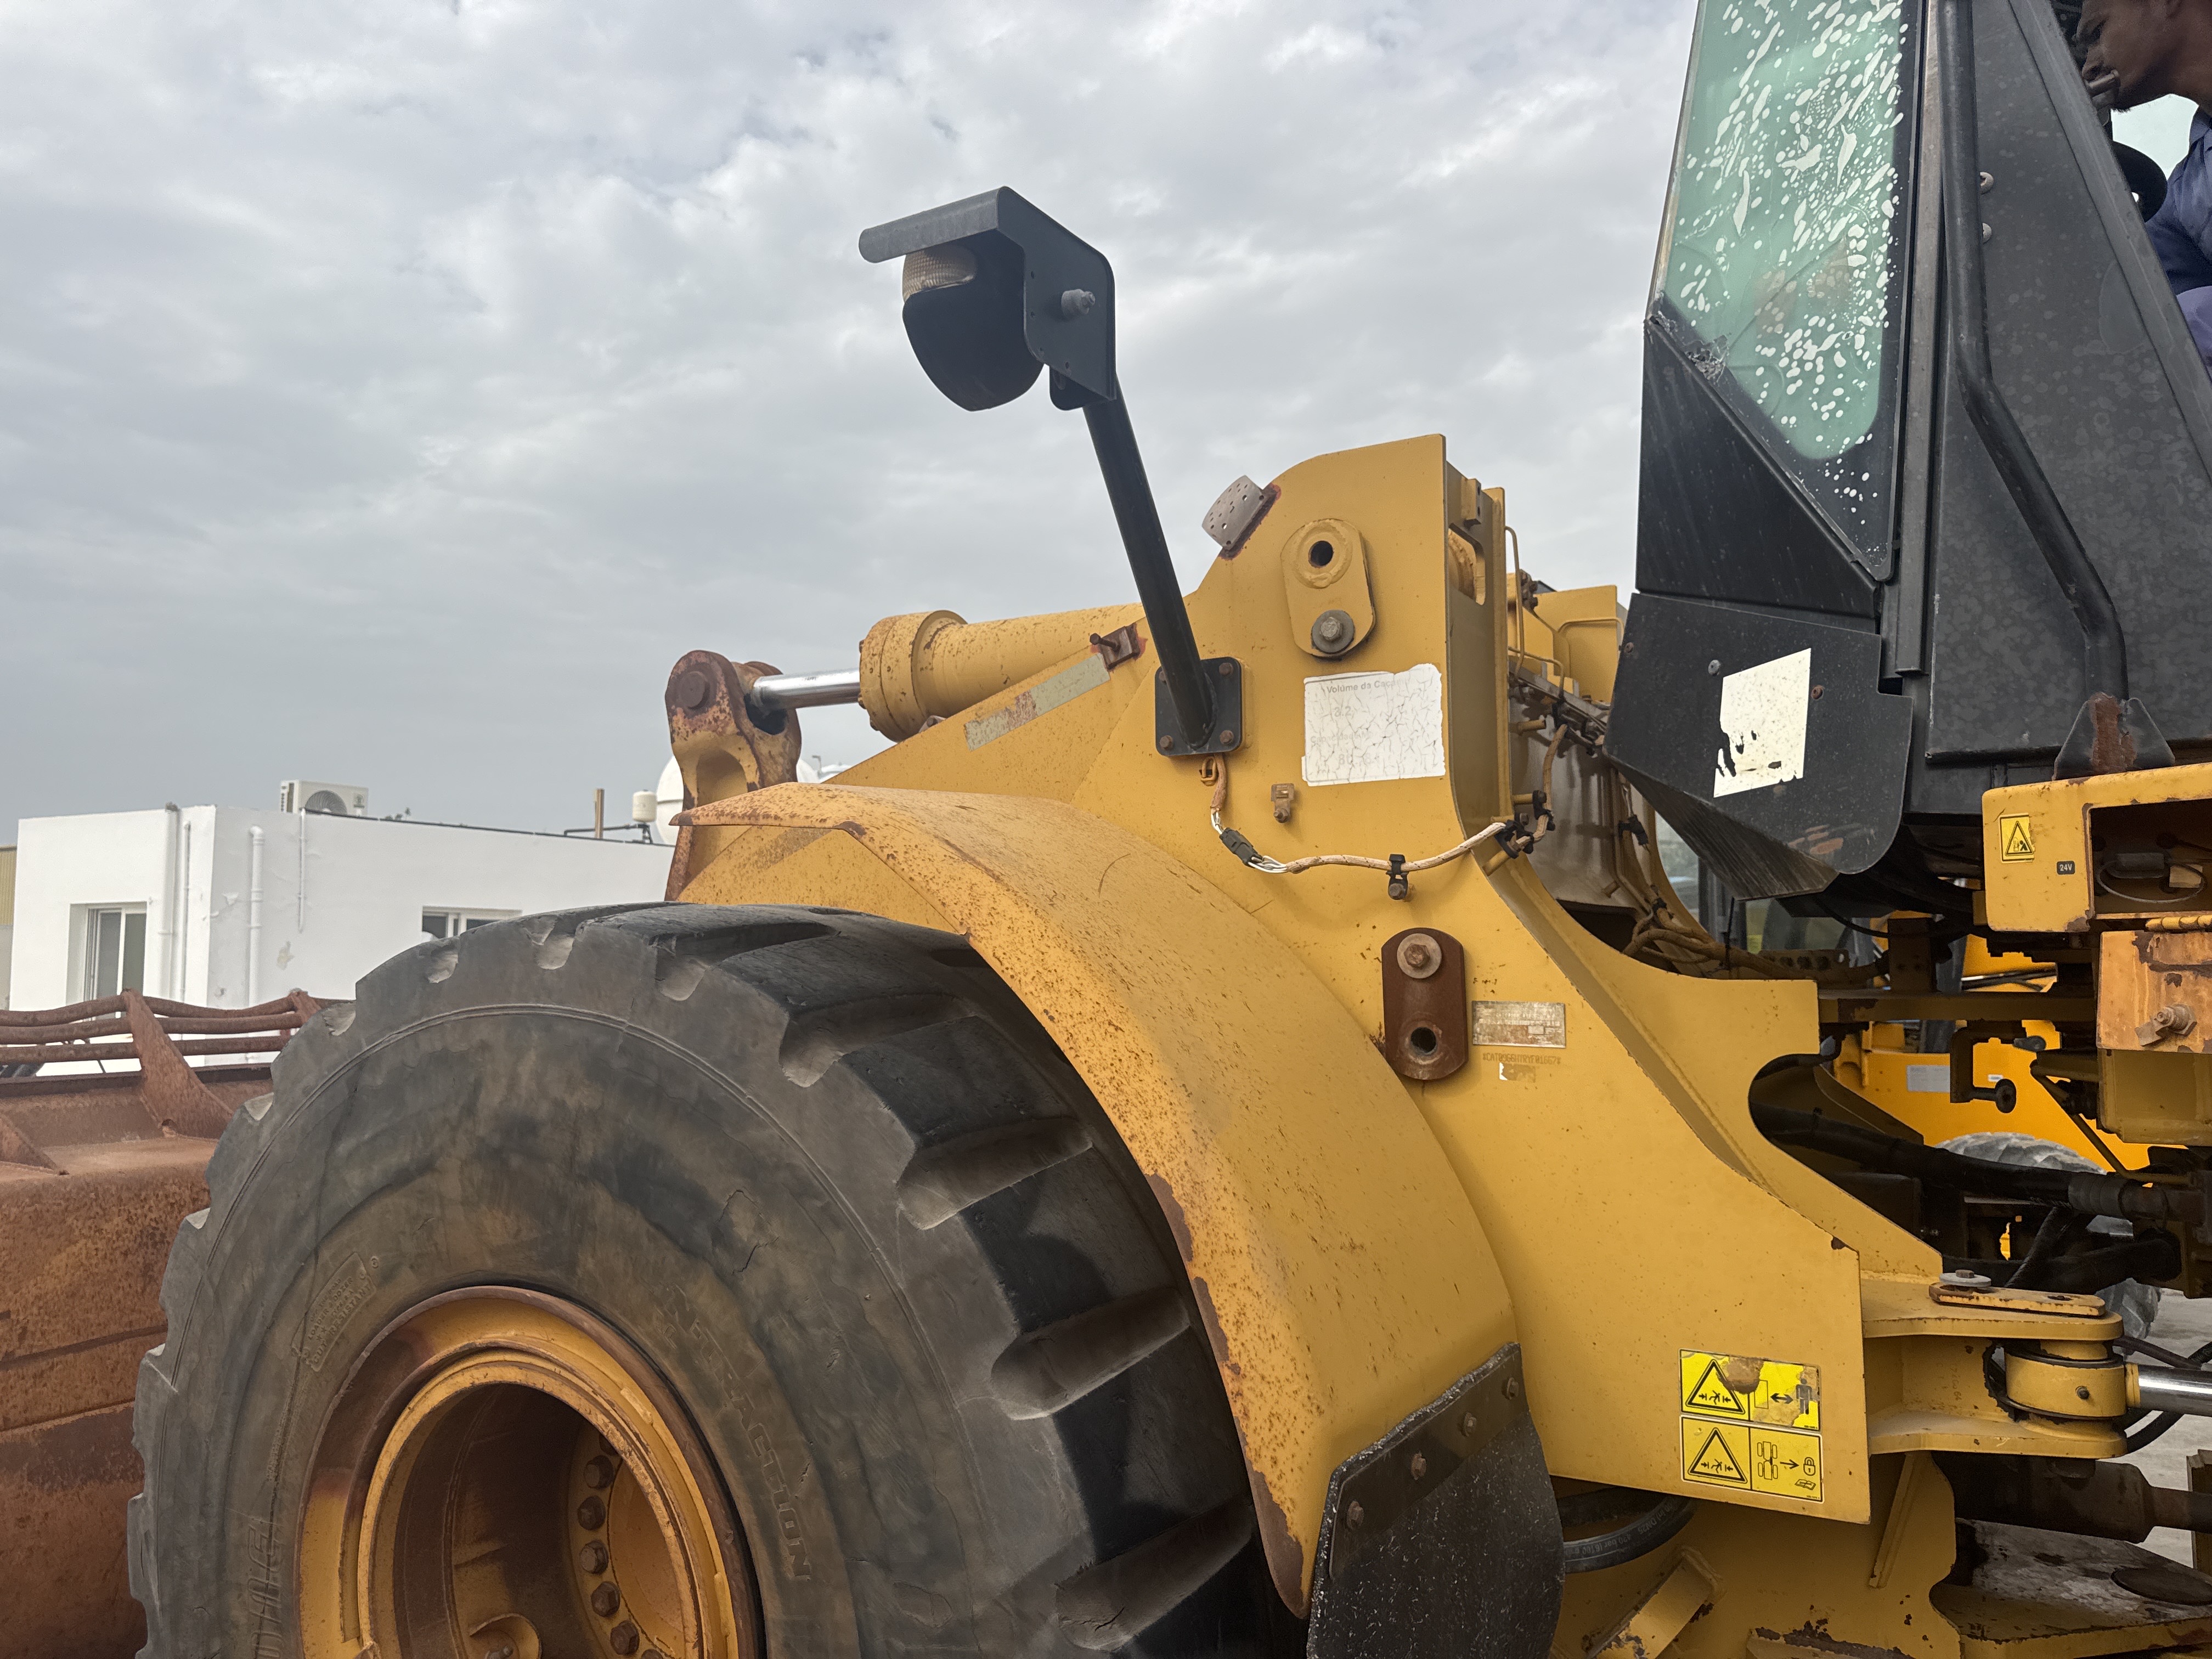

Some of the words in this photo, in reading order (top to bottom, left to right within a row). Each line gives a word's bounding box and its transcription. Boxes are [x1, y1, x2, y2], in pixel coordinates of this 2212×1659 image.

[1361, 682, 1372, 690] da
[308, 1309, 329, 1340] LOADER
[333, 1277, 354, 1301] DOZER
[314, 1340, 328, 1364] CUT
[329, 1283, 371, 1336] RESISTANT
[1604, 1539, 1617, 1548] bar
